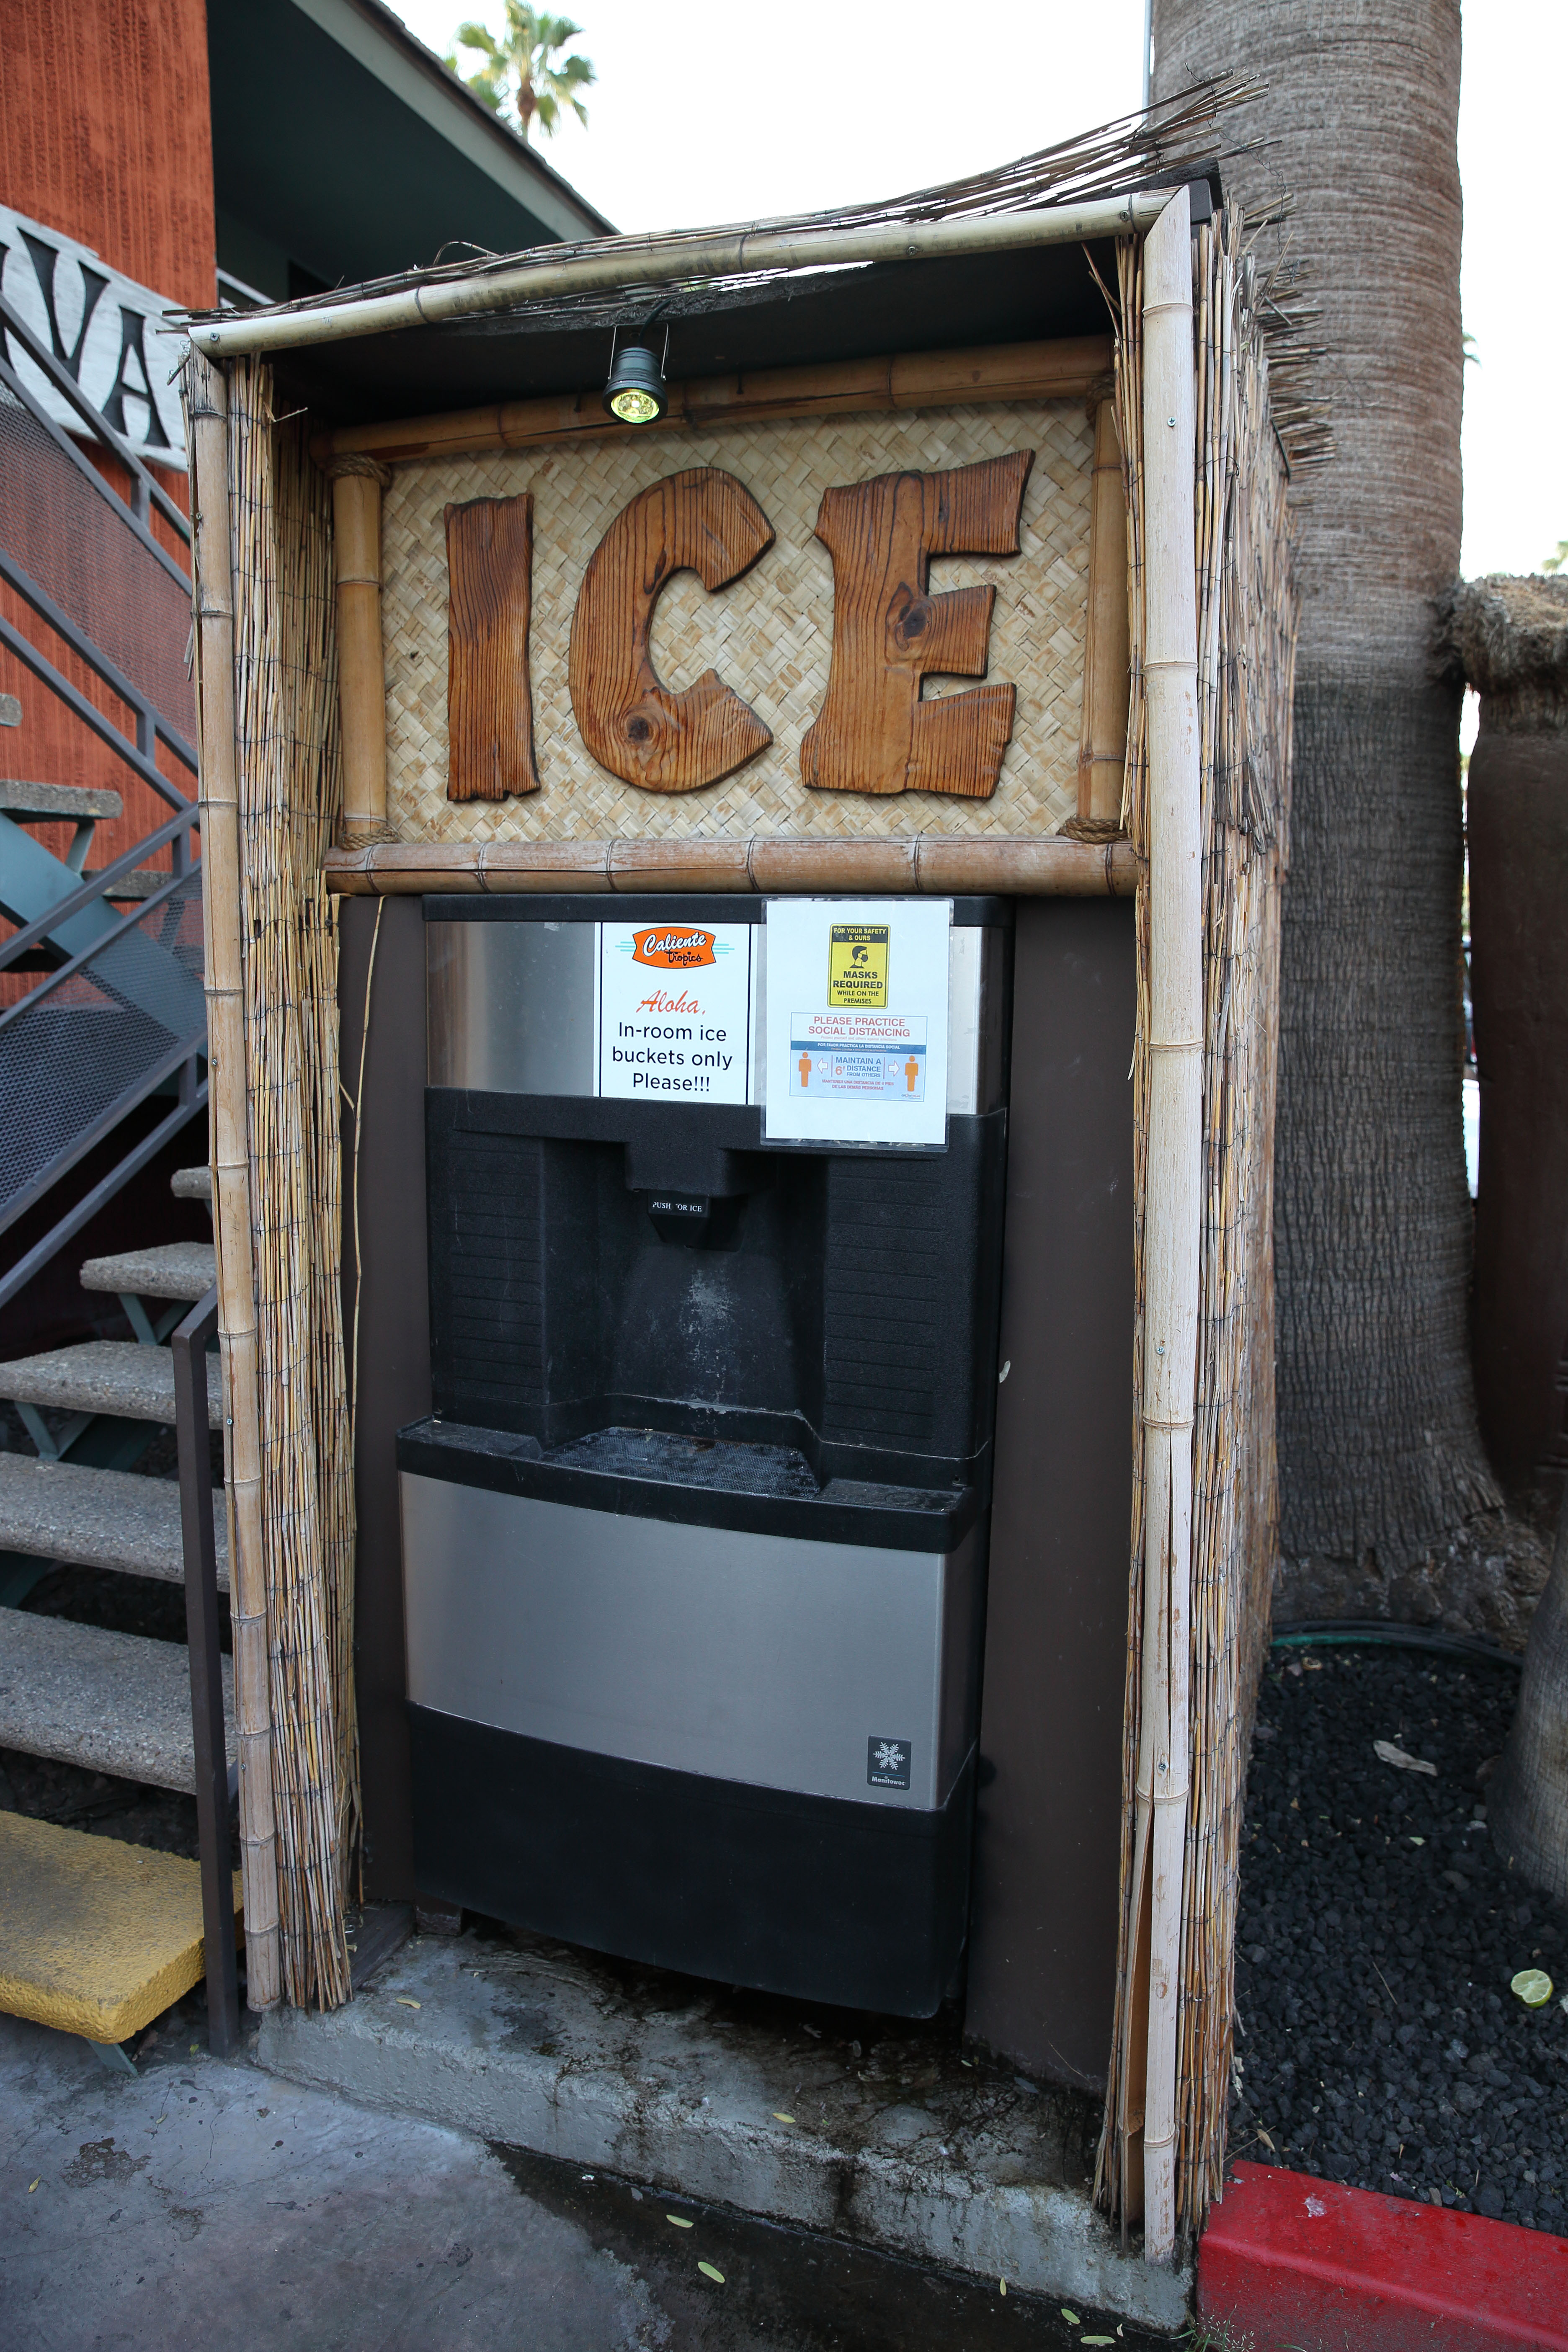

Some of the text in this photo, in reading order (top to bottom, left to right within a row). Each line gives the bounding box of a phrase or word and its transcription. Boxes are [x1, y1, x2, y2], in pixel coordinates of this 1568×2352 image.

[0, 227, 171, 448] VA
[444, 449, 1035, 802] ICE
[643, 932, 707, 957] Caliente
[636, 990, 706, 1015] Aloha,
[814, 1016, 905, 1026] PLEASE PRACTICE
[619, 1022, 727, 1042] In-room ice
[808, 1026, 910, 1037] SOCIAL DISTANCING
[613, 1046, 733, 1070] buckets only
[836, 1066, 845, 1075] 6'
[633, 1073, 709, 1091] Please!!!
[872, 1776, 905, 1786] Manitowoc
